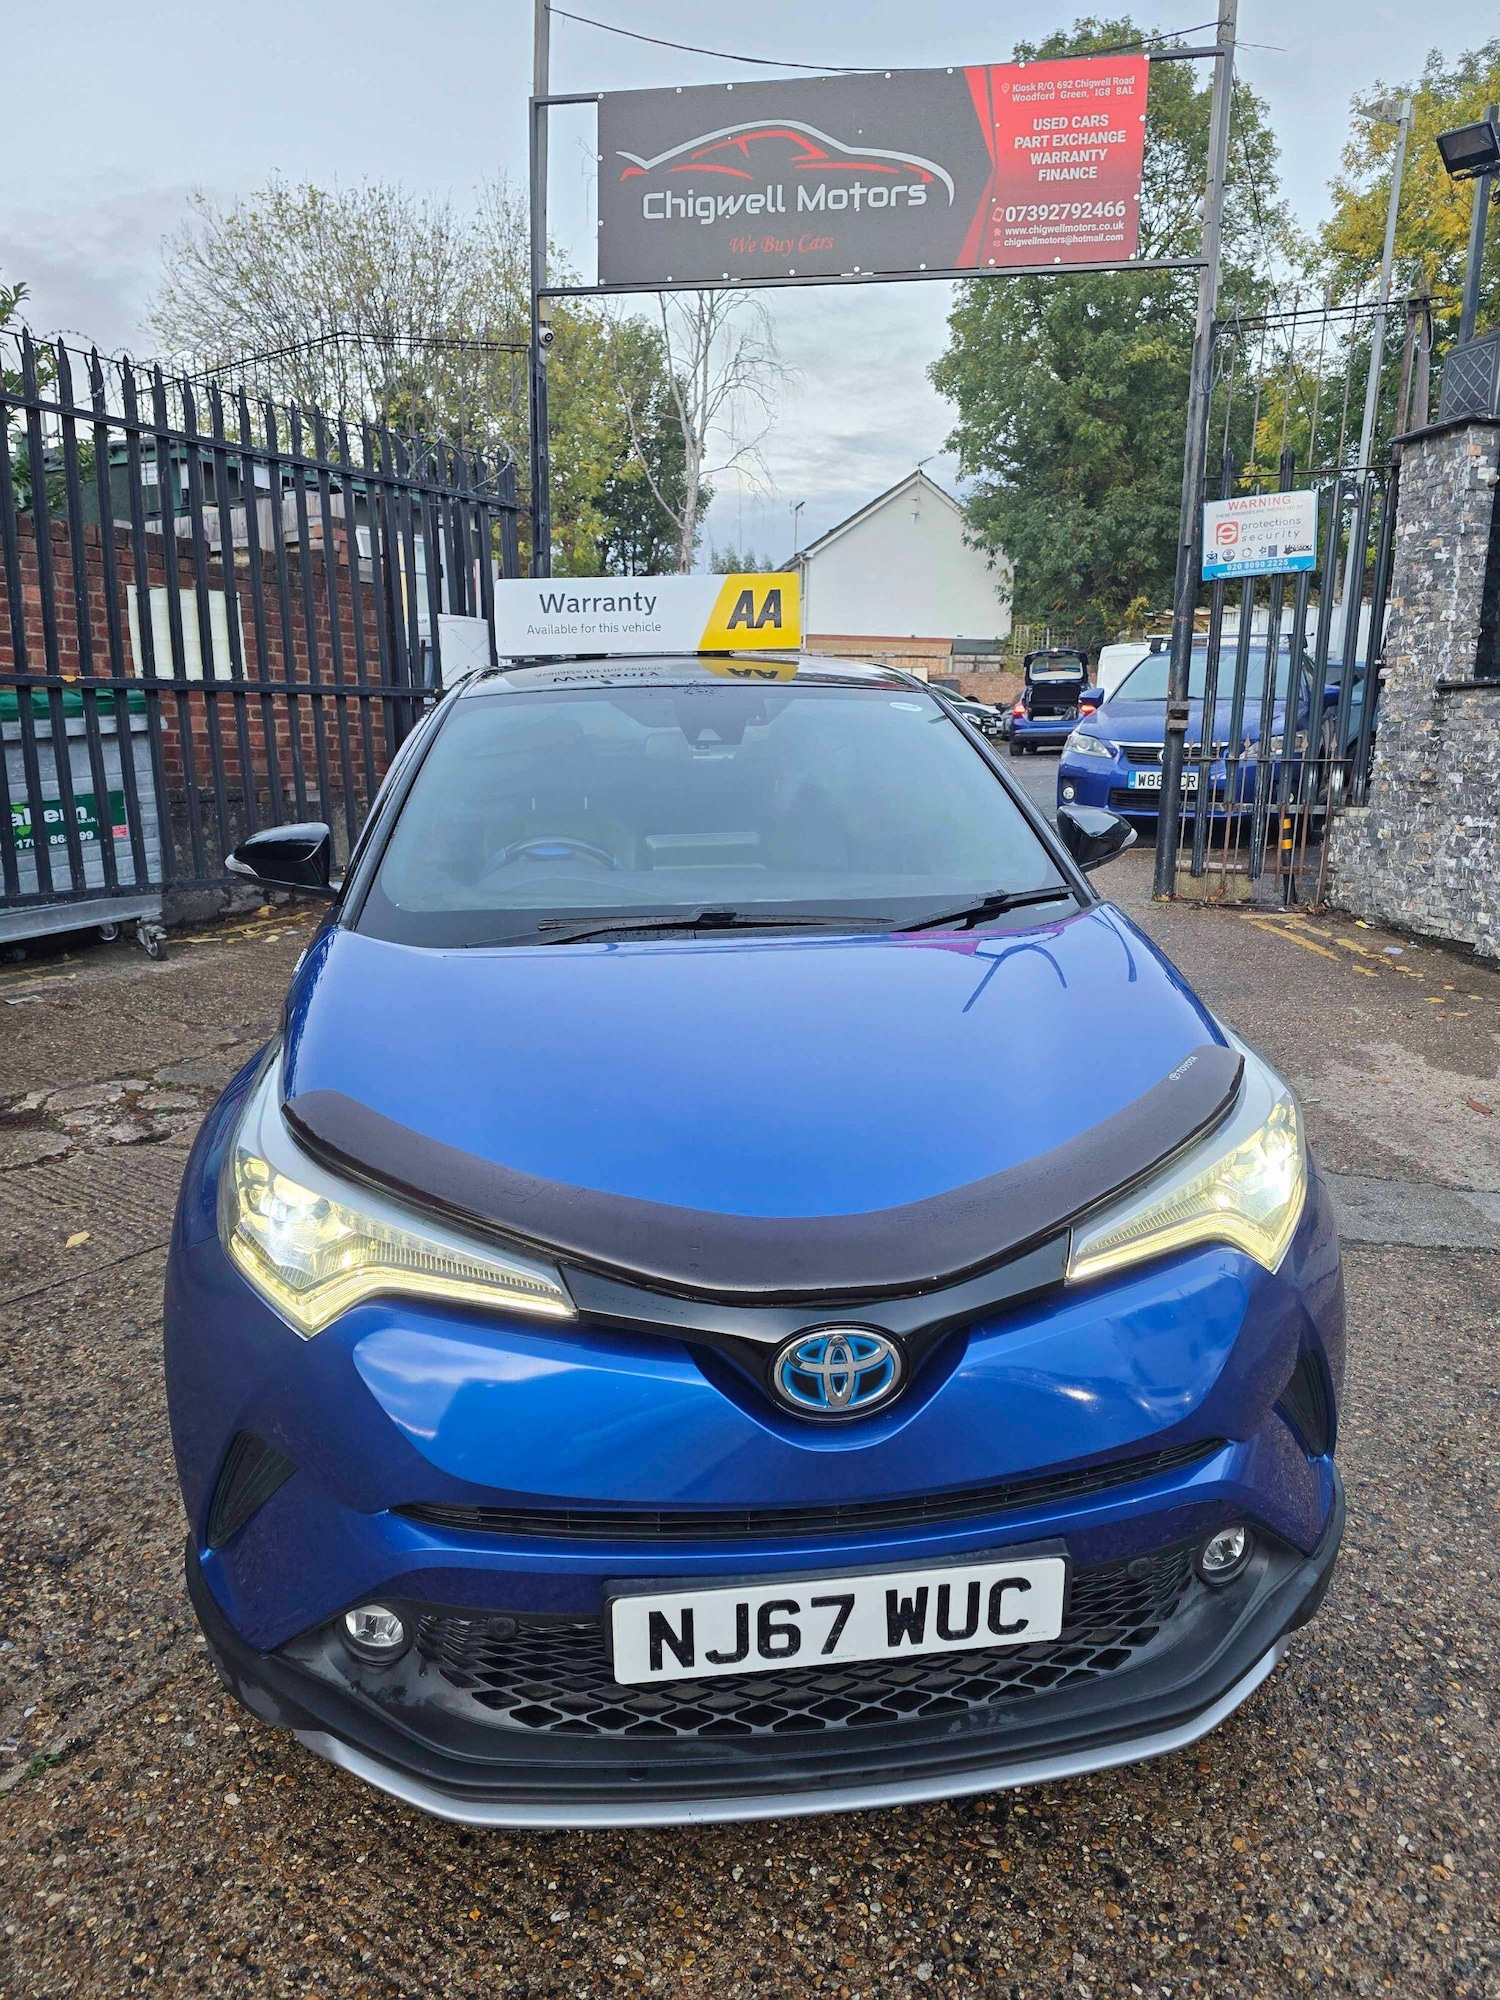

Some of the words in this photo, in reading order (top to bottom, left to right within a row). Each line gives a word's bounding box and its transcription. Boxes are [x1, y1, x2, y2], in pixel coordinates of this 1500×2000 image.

[1012, 82, 1036, 93] Kiosk
[1057, 80, 1074, 89] 692
[1074, 77, 1112, 89] Chigwell
[1112, 75, 1136, 85] Road
[1012, 91, 1056, 102] Woodford
[1060, 88, 1090, 99] Green,
[1095, 87, 1111, 97] IG8
[1116, 86, 1135, 96] 8AL
[1032, 116, 1069, 131] USED
[1071, 114, 1109, 128] CARS
[1014, 135, 1050, 149] PART
[1052, 130, 1127, 147] EXCHANGE
[1030, 148, 1108, 165] WARRANTY
[1038, 166, 1098, 181] FINANCE
[642, 184, 786, 225] Chigwell
[796, 181, 928, 212] Motors
[1005, 200, 1127, 223] 07392792466
[1004, 220, 1125, 236] www.chigwellmotors.co.uk
[729, 235, 756, 255] We
[761, 235, 795, 258] Buy
[799, 233, 835, 251] Cars
[1004, 233, 1124, 248] chigwellmotors@hotmail.com
[1228, 495, 1292, 511] WARNING
[1241, 516, 1302, 531] protections
[1241, 530, 1300, 543] security
[1226, 562, 1242, 571] 020
[539, 591, 657, 616] Warranty
[726, 588, 782, 630] AA
[526, 622, 578, 635] Available
[581, 621, 597, 634] for
[598, 621, 619, 634] this
[622, 620, 662, 633] vehicle
[1175, 1055, 1199, 1074] TOYOTA
[648, 1593, 856, 1672] NJ67
[885, 1577, 1033, 1648] WUC
